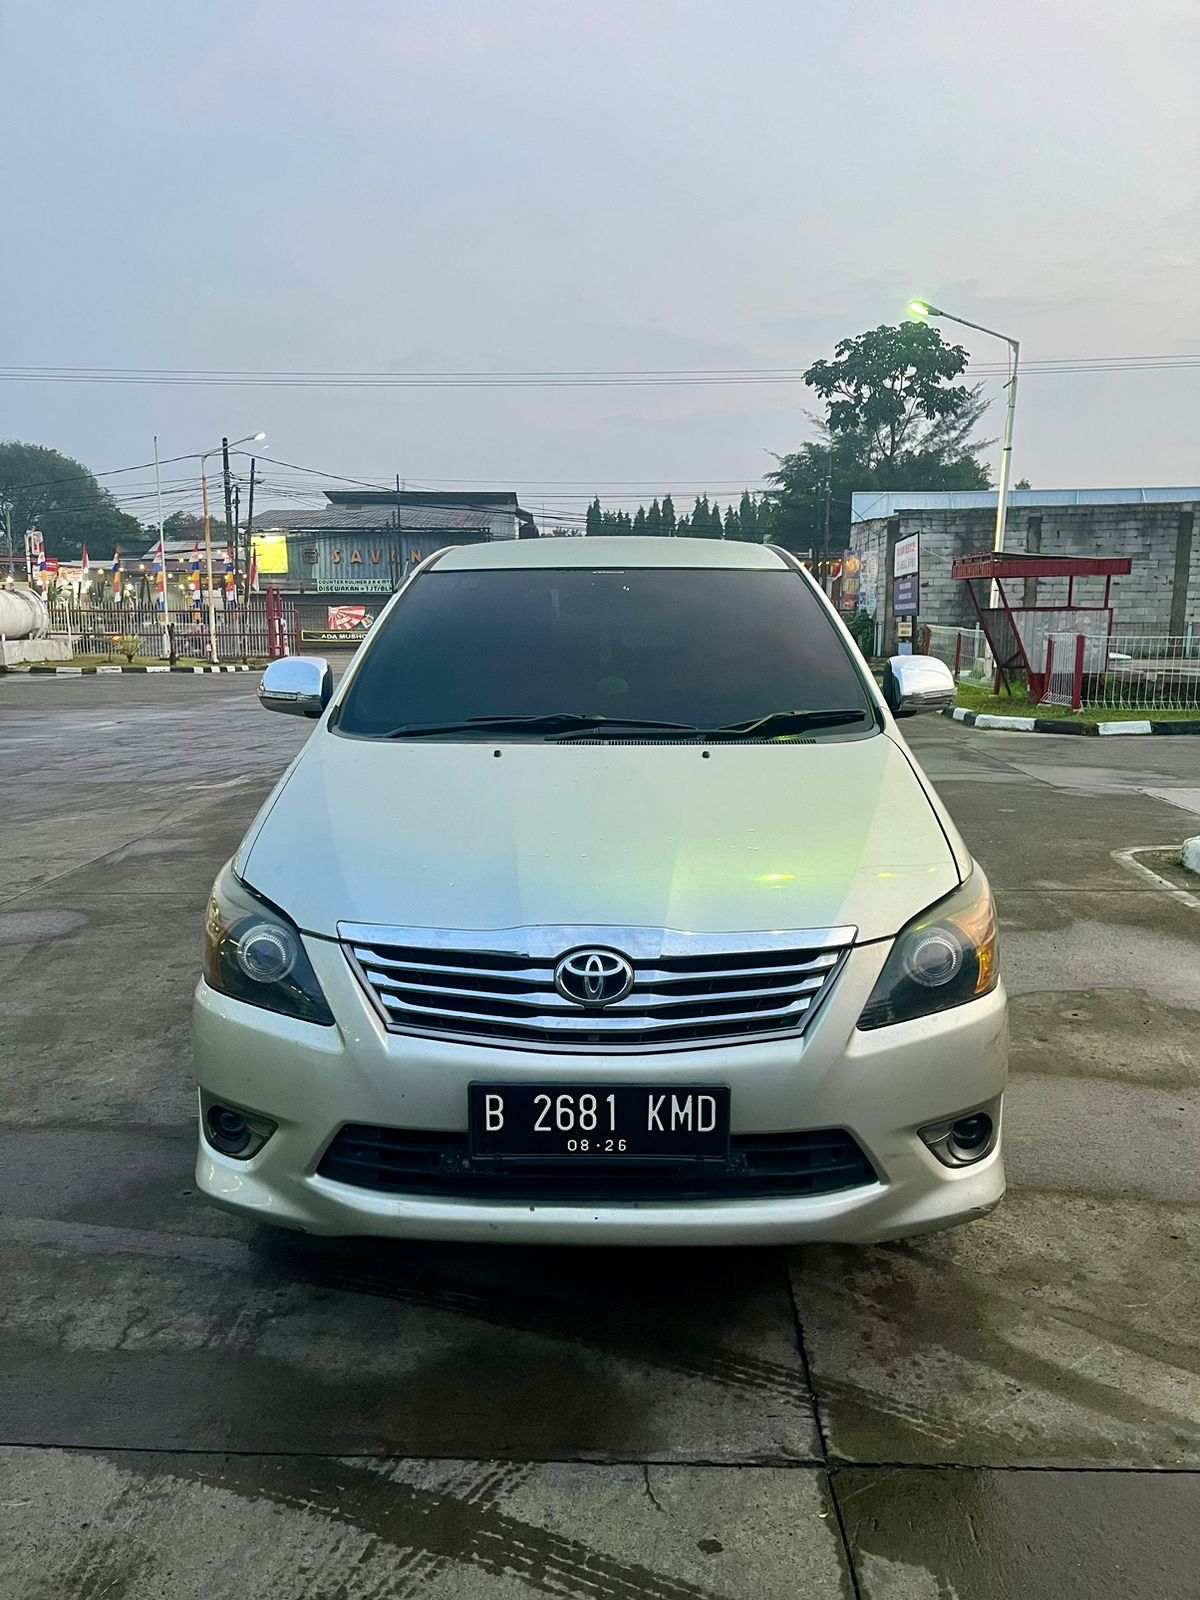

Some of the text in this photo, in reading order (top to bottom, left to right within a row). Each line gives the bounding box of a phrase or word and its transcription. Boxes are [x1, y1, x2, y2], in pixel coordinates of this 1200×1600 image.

[485, 1093, 716, 1132] B 2681 KMD
